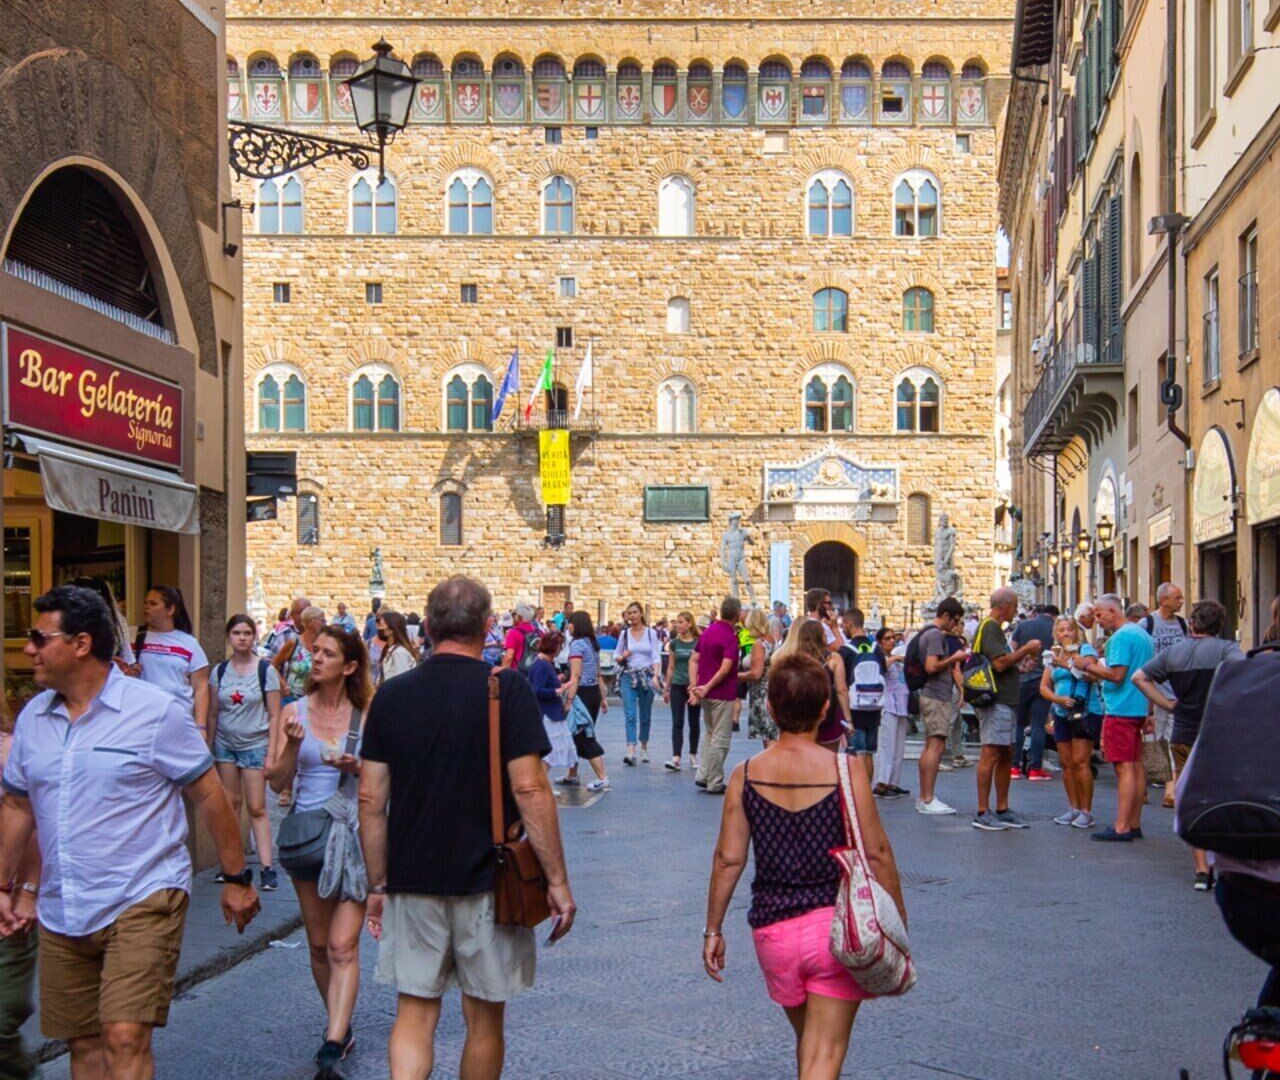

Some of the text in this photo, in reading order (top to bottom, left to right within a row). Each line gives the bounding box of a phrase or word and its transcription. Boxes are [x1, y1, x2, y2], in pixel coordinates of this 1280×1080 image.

[19, 348, 175, 430] Bar Gelateria
[127, 419, 173, 451] Signoria
[542, 461, 558, 469] PER
[97, 477, 156, 522] Panini
